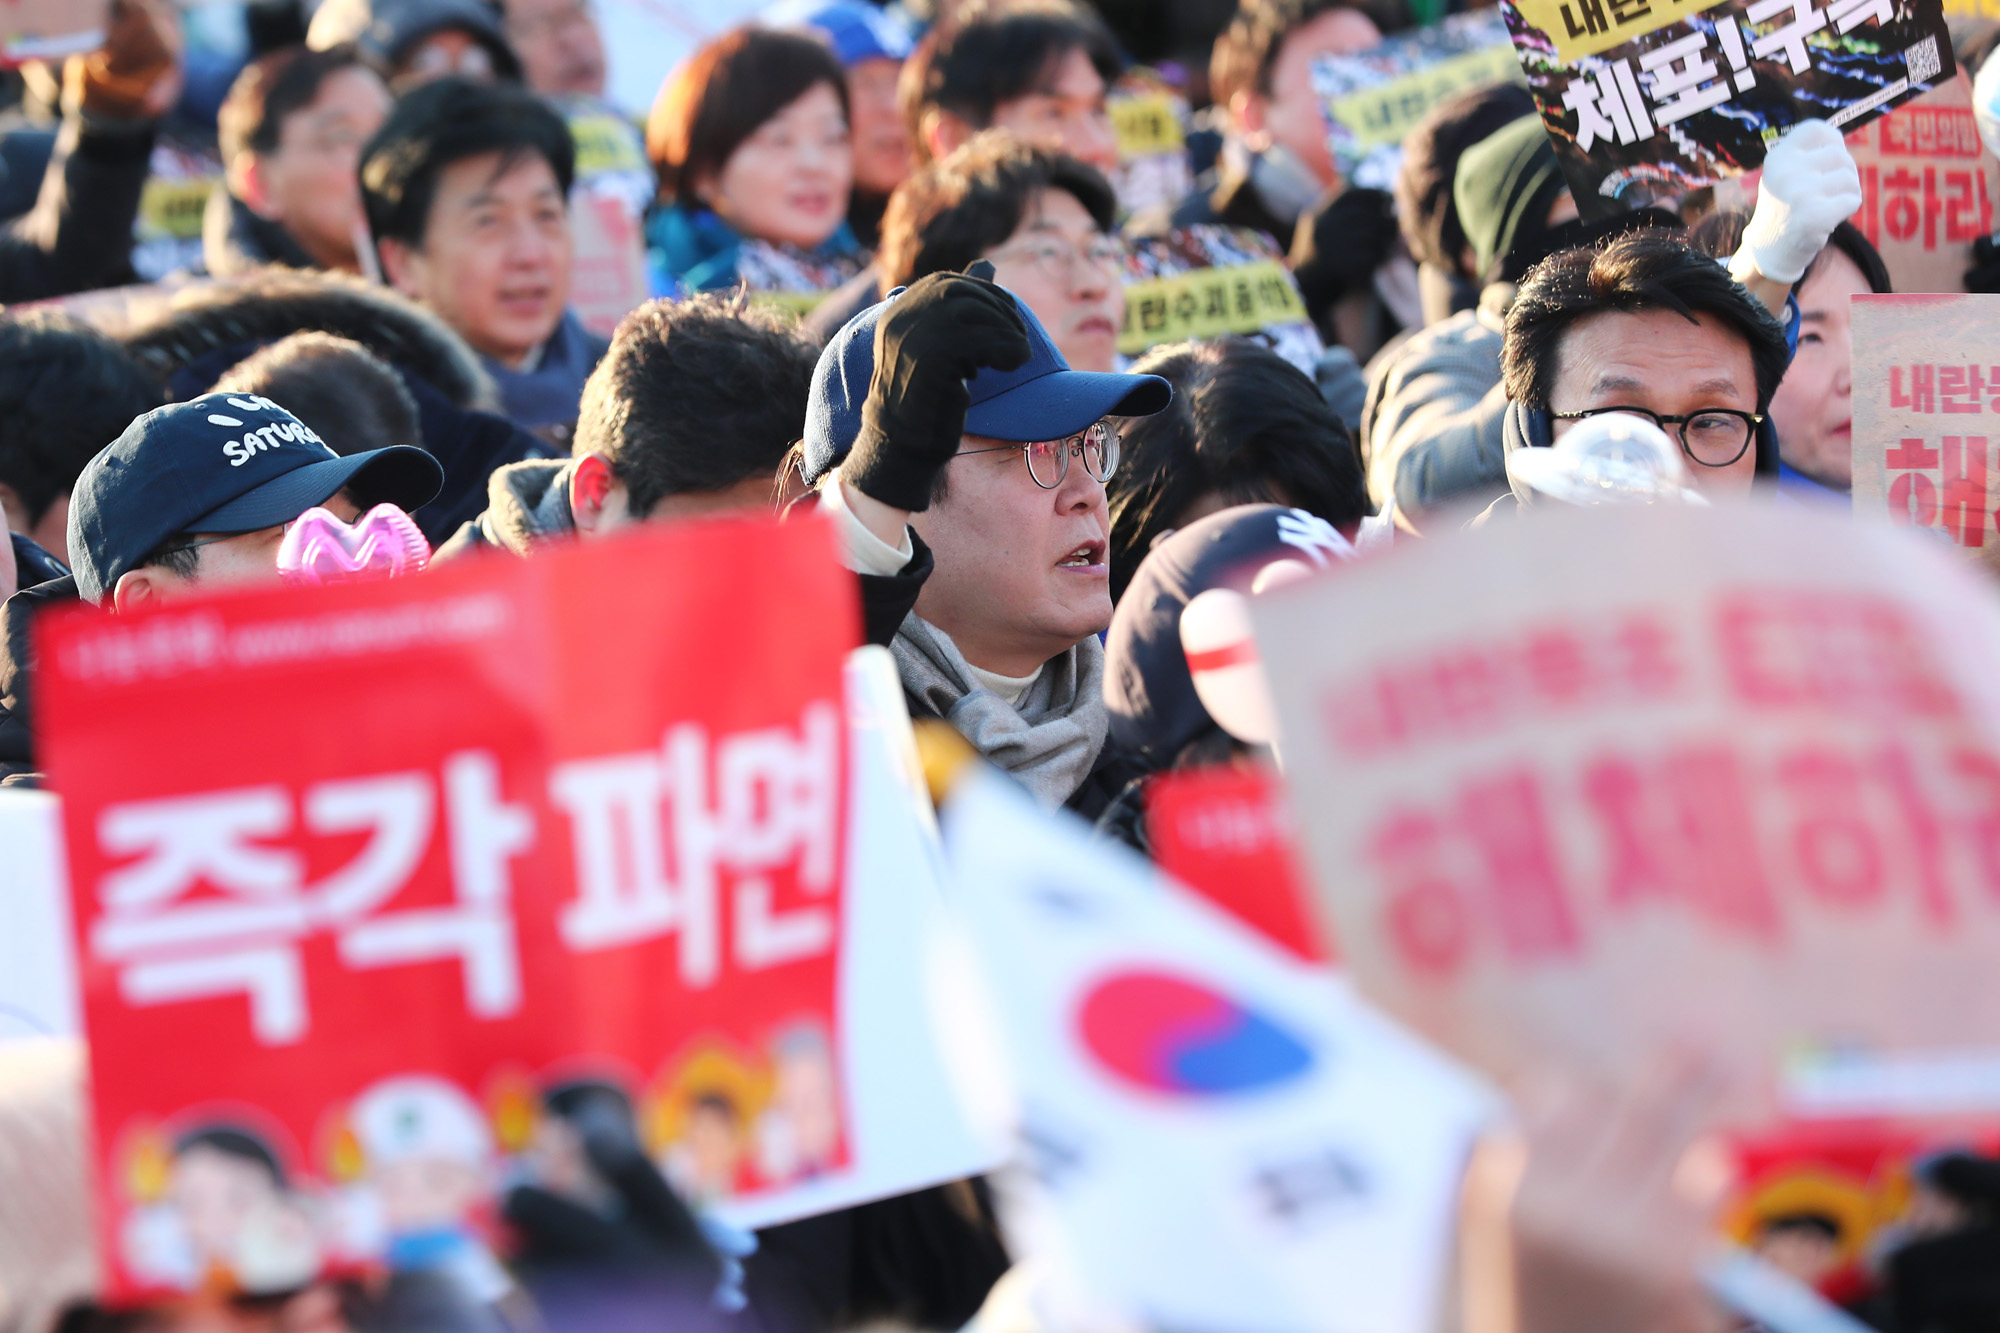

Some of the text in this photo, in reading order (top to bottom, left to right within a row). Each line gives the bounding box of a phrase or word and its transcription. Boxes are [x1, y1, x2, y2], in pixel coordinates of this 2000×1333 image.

[1889, 364, 2000, 414] 내란
[1885, 435, 2000, 547] 해
[92, 703, 841, 1045] 즉각 파면
